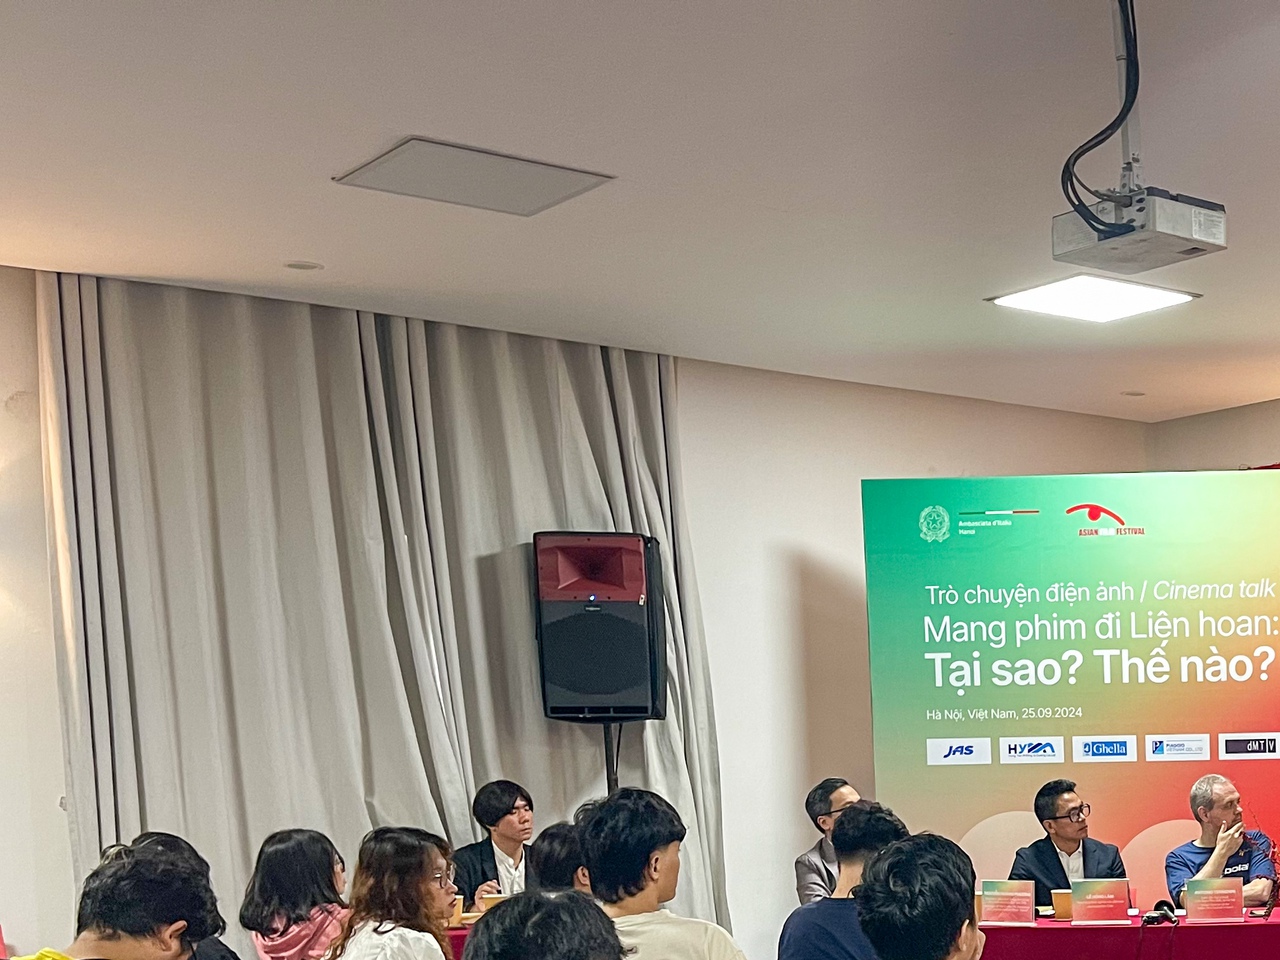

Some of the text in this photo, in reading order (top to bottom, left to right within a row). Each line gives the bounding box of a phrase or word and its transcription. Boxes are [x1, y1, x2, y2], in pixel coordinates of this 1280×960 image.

[1079, 528, 1098, 536] ASIAN
[1116, 527, 1145, 535] FESTIVAL
[925, 578, 1277, 608] Trò chuyện điện ảnh / Cinema talk
[924, 610, 1280, 649] Mang phim đi Liên hoan:
[924, 640, 1277, 697] Tại sao? Thế nào?
[926, 706, 1083, 722] Hà Nội, Việt Nam, 25.09.2024
[943, 745, 974, 758] JAS
[1093, 743, 1126, 755] Ghella
